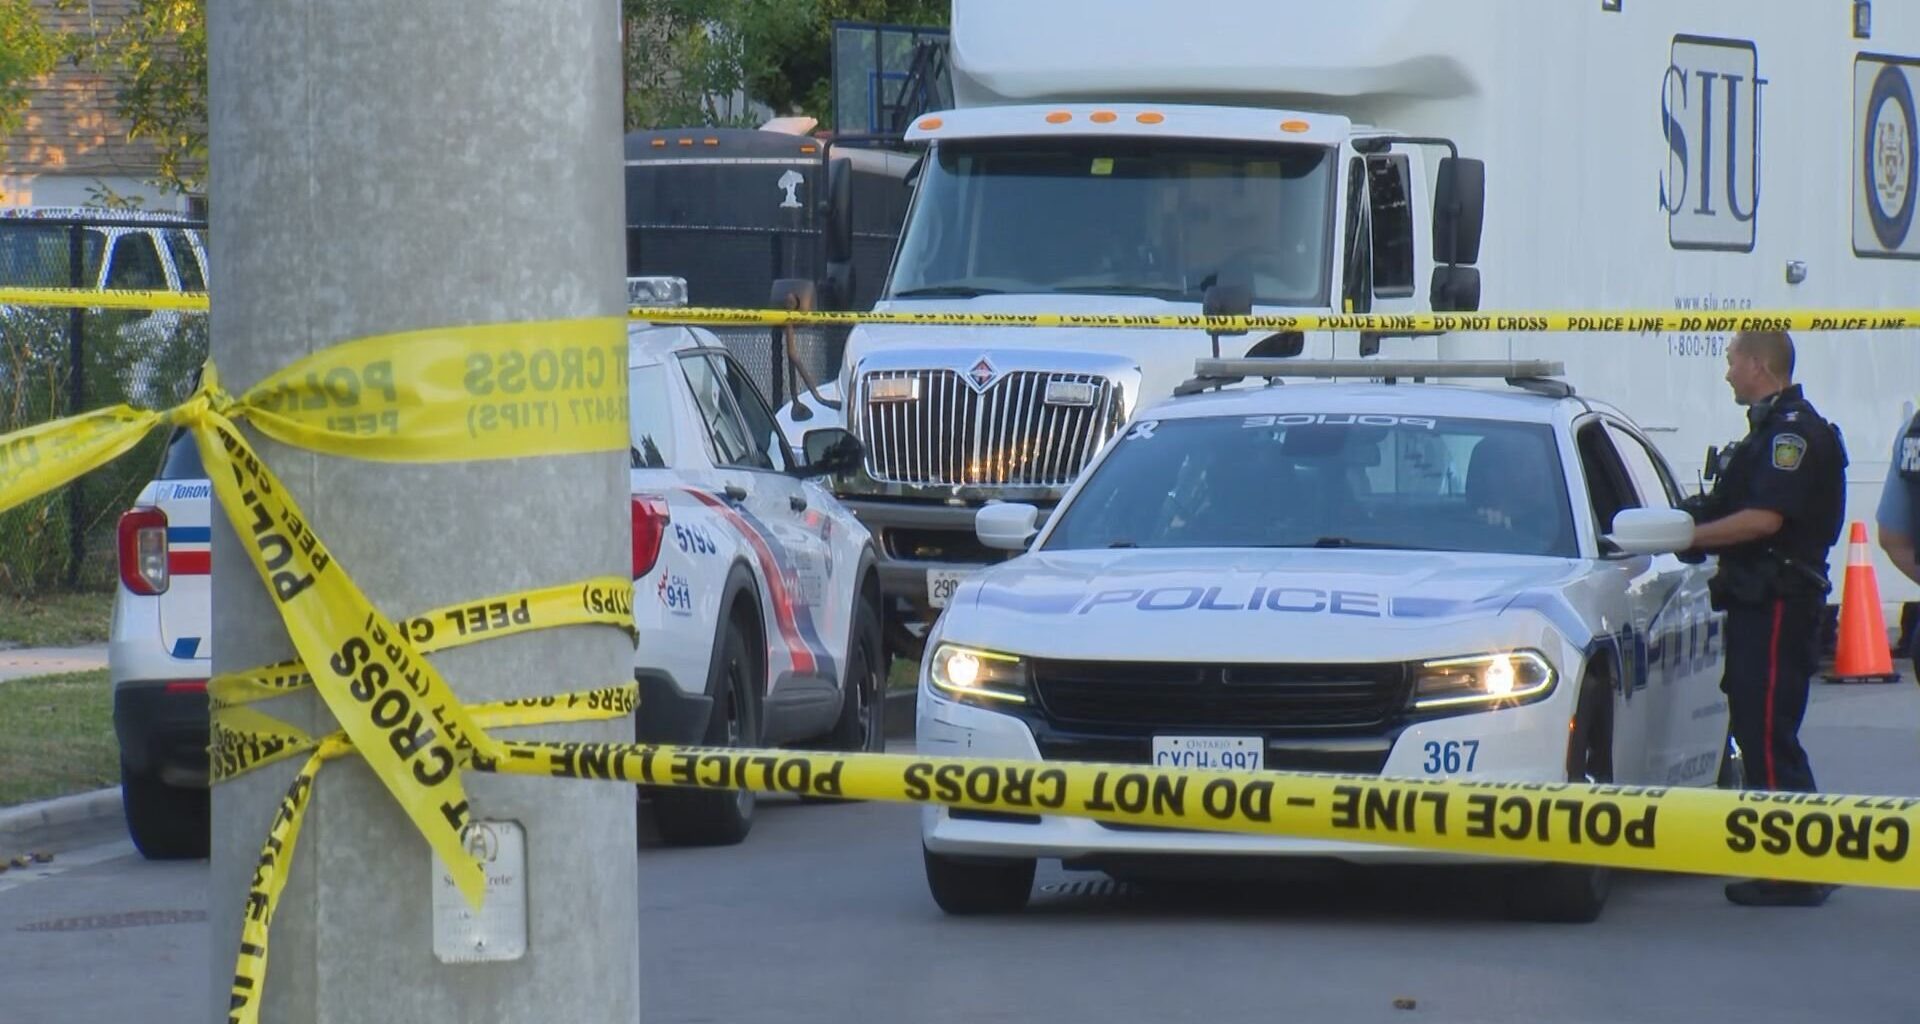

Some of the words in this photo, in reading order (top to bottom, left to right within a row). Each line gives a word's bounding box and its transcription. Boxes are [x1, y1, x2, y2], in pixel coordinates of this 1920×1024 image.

[1658, 65, 1768, 222] SIU
[1380, 316, 1416, 329] LINE
[1434, 316, 1455, 330] DO
[1461, 317, 1492, 330] NOT
[1497, 317, 1548, 331] CROSS
[1567, 316, 1623, 331] POLICE
[1628, 317, 1664, 333] LINE
[1680, 317, 1702, 332] DO
[1705, 317, 1738, 332] NOT
[1740, 317, 1792, 332] CROSS
[1810, 318, 1862, 330] POLICE
[1868, 318, 1906, 330] LINE
[446, 598, 531, 636] PEEL
[1078, 586, 1381, 618] POLICE
[330, 637, 454, 787] CROSS
[550, 747, 656, 783] LINE
[671, 754, 845, 796] POLICE
[1423, 740, 1480, 775] 367
[904, 763, 1067, 809] CROSS
[1084, 772, 1188, 816] NOT
[1202, 778, 1275, 823] DO
[1332, 785, 1449, 835] LINE
[1466, 794, 1658, 849] POLICE
[1726, 807, 1910, 864] CROSS
